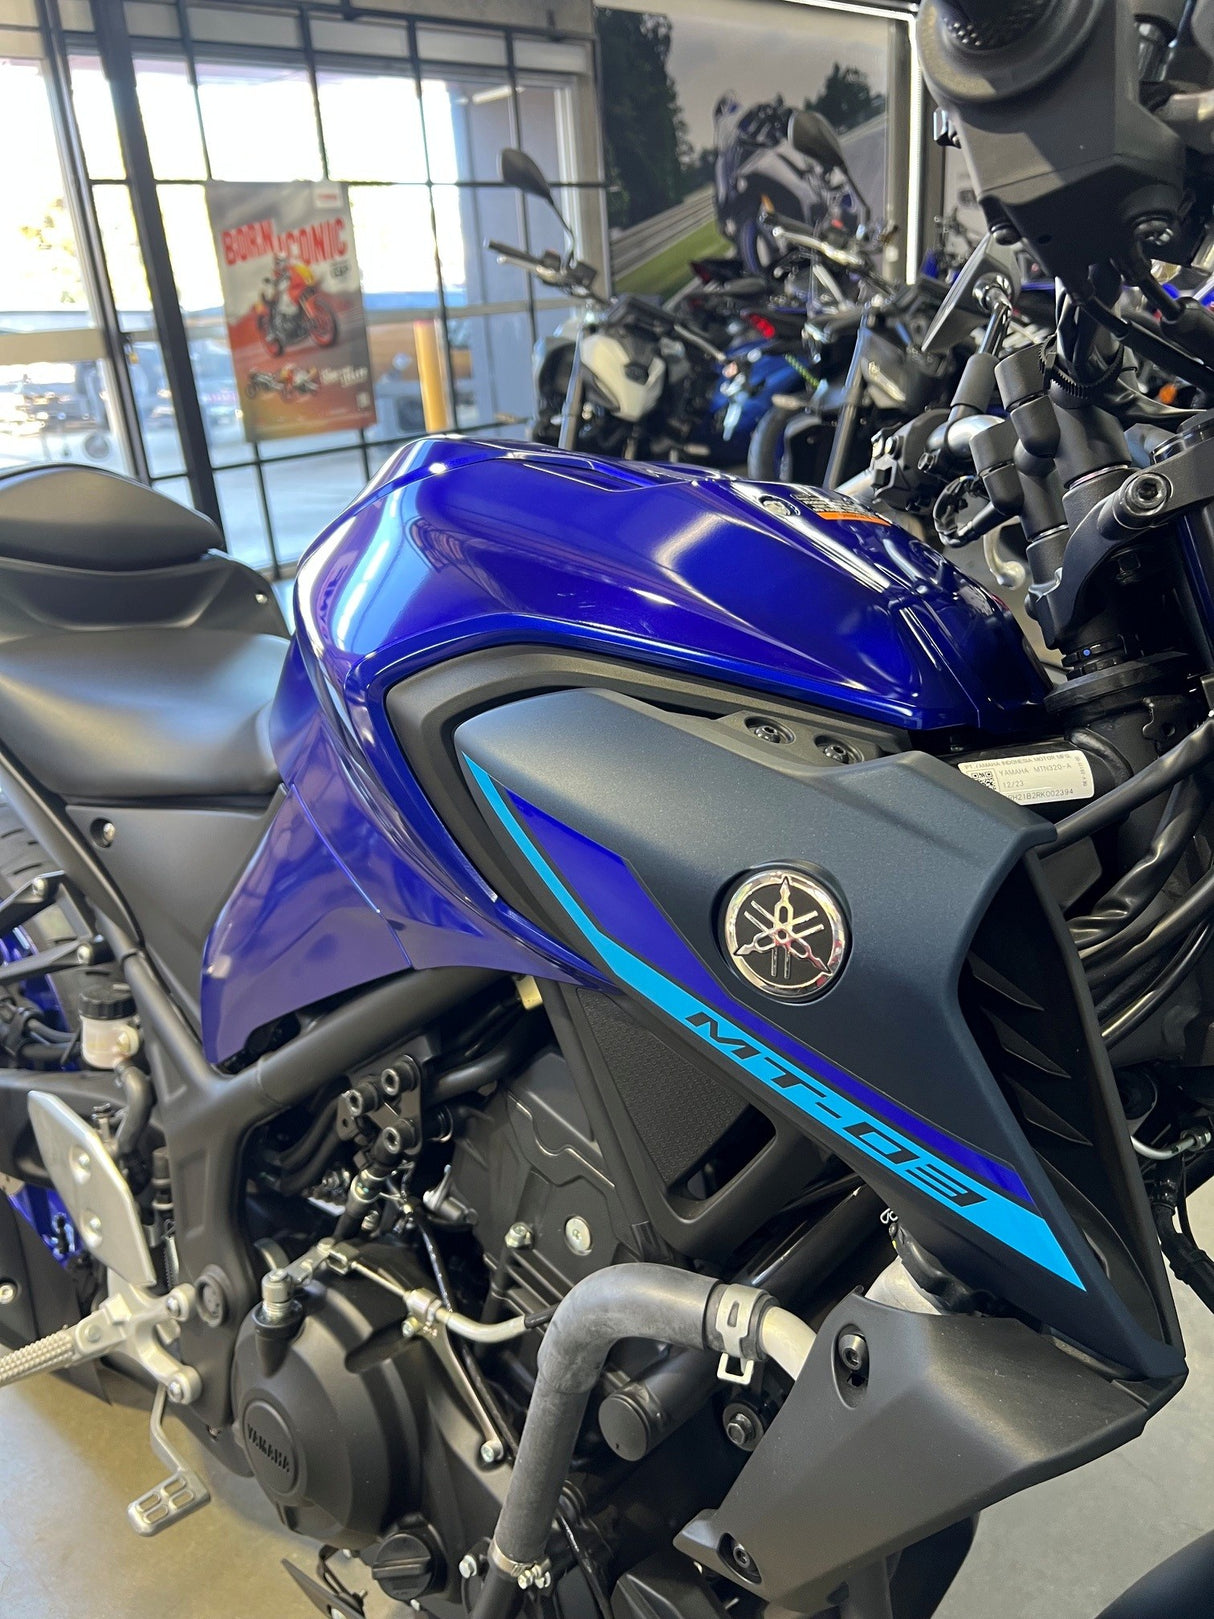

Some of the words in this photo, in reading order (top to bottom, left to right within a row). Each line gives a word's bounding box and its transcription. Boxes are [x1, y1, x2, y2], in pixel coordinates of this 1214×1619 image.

[222, 219, 274, 265] BORN
[276, 217, 348, 265] ICONIC
[999, 767, 1029, 777] YAMAHA
[1033, 763, 1072, 774] MTN320-A
[1002, 758, 1033, 766] INDONESIA
[685, 1011, 988, 1208] MT-03
[247, 1423, 290, 1473] YAMAHA
